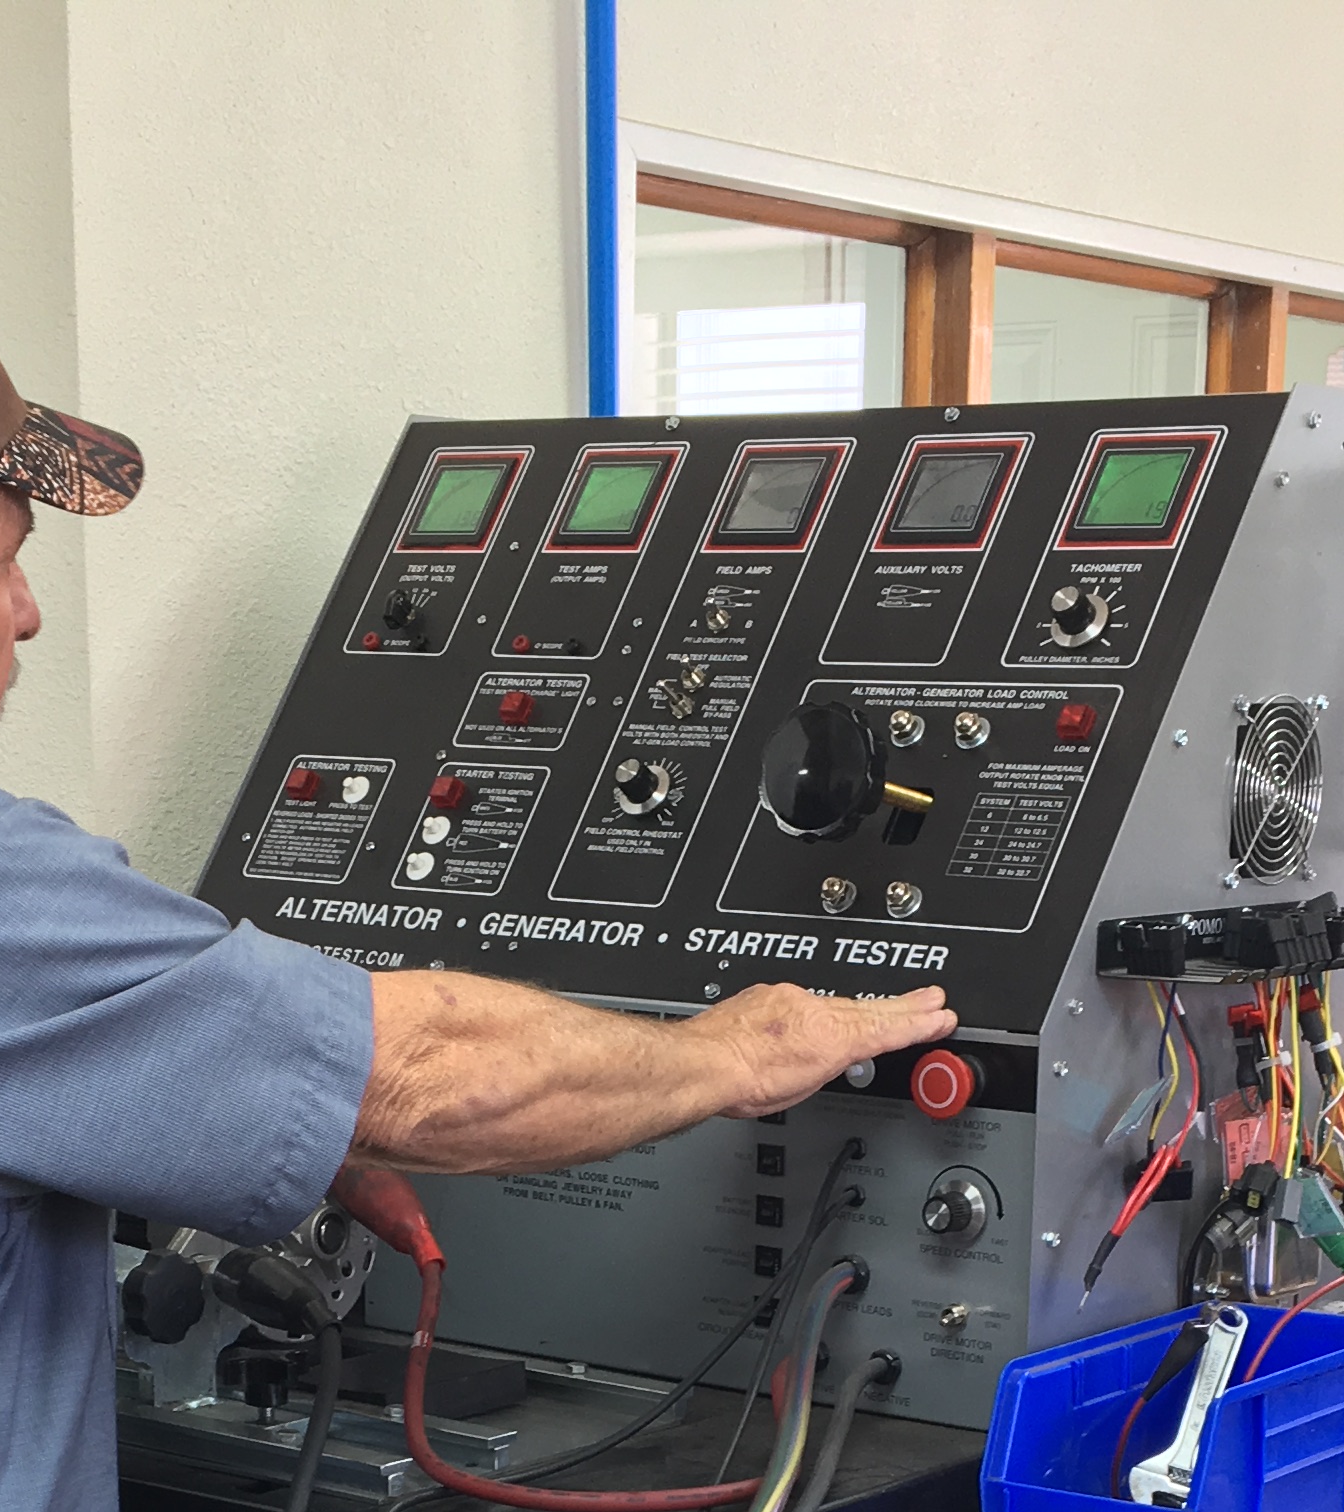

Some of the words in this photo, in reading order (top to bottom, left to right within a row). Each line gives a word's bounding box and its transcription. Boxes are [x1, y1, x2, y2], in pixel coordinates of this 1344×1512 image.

[407, 564, 428, 573] TEST
[429, 564, 456, 574] VOLTS
[558, 565, 581, 574] TEST
[582, 565, 608, 574] AMPS
[716, 566, 742, 575] FIELD
[745, 566, 772, 576] AMPS
[875, 565, 927, 575] AUXILIARY
[931, 565, 964, 575] VOLTS
[1070, 563, 1142, 573] TACHOMETER
[690, 620, 698, 628] A
[744, 620, 753, 629] B
[689, 654, 707, 662] TEST
[708, 654, 749, 662] SELECTOR
[1019, 655, 1049, 663] PULLEY
[484, 678, 542, 688] ALTERNATOR
[545, 679, 584, 689] TESTING
[851, 686, 916, 697] ALTERNATOR
[922, 688, 984, 698] GENERATOR
[987, 689, 1018, 699] LOAD
[1019, 690, 1069, 700] CONTROL
[865, 699, 892, 707] ROTATE
[1023, 702, 1046, 710] LOAD
[1053, 745, 1075, 753] LOAD
[295, 761, 351, 772] ALTERNATOR
[353, 763, 389, 774] TESTING
[455, 769, 495, 779] STARTER
[979, 771, 1009, 779] OUTPUT
[1010, 772, 1040, 781] ROTATE
[993, 781, 1012, 790] TEST
[1013, 782, 1038, 791] VOLTS
[1039, 783, 1064, 792] EQUAL
[979, 797, 1012, 807] SYSTEM
[1018, 799, 1038, 808] TEST
[1039, 800, 1064, 809] VOLTS
[606, 828, 642, 837] CONTROL
[1190, 916, 1224, 937] POMO
[275, 897, 443, 931] ALTERNATOR
[479, 912, 645, 947] GENERATOR
[685, 928, 819, 960] STARTER
[833, 938, 949, 970] TESTER
[963, 1120, 1002, 1132] MOTOR
[578, 1171, 609, 1184] LOOSE
[612, 1175, 660, 1190] CLOTHING
[512, 1175, 558, 1190] DANGLING
[561, 1182, 604, 1197] JEWELRY
[605, 1189, 633, 1200] AWAY
[503, 1186, 529, 1199] FROM
[558, 1194, 593, 1208] PULLEY
[919, 1243, 952, 1256] SPEED
[953, 1249, 1004, 1264] CONTROL
[861, 1303, 893, 1317] LEADS
[922, 1331, 953, 1346] DRIVE
[955, 1337, 993, 1351] MOTOR
[929, 1347, 985, 1364] DIRECTION
